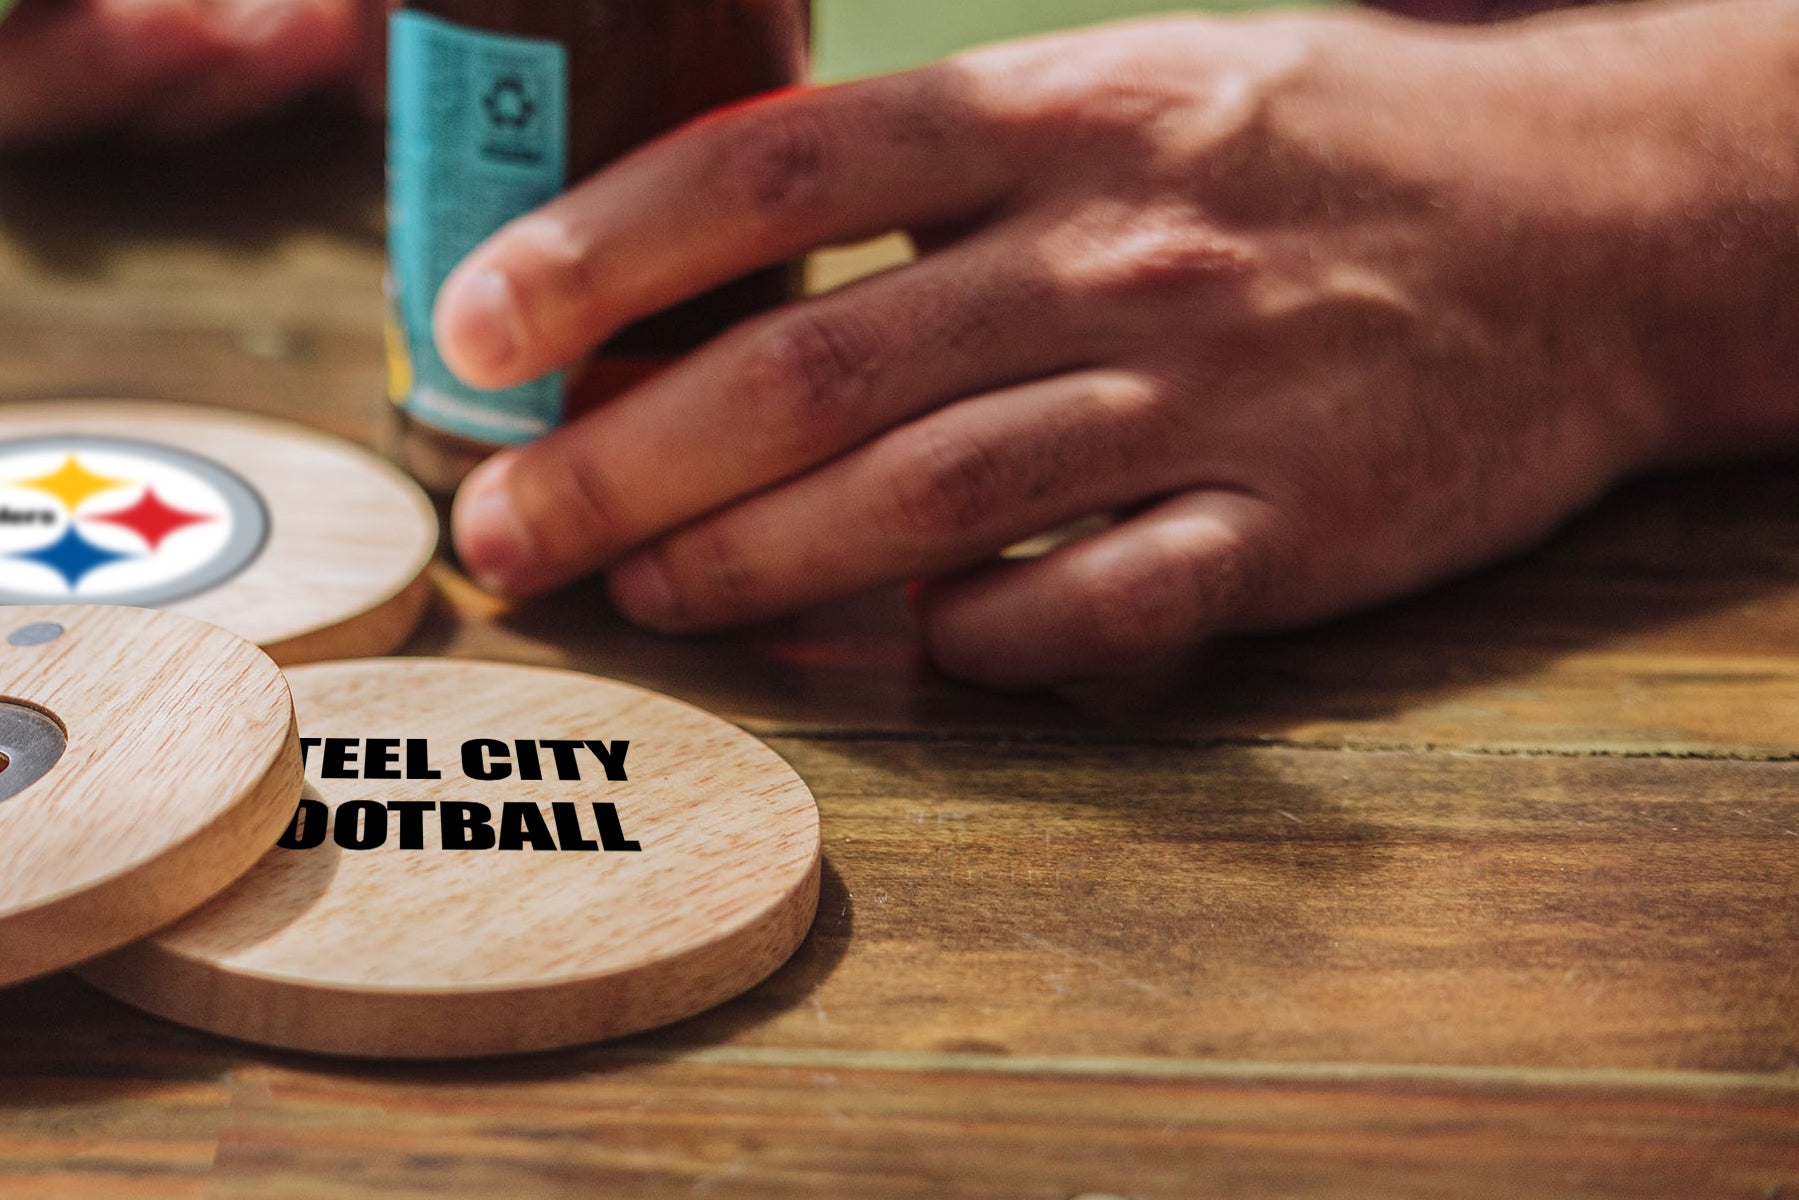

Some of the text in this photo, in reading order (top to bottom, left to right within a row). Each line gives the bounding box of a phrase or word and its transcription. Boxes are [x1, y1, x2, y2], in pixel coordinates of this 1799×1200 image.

[299, 737, 630, 781] EEL CITY
[275, 799, 642, 852] OOTBALL
